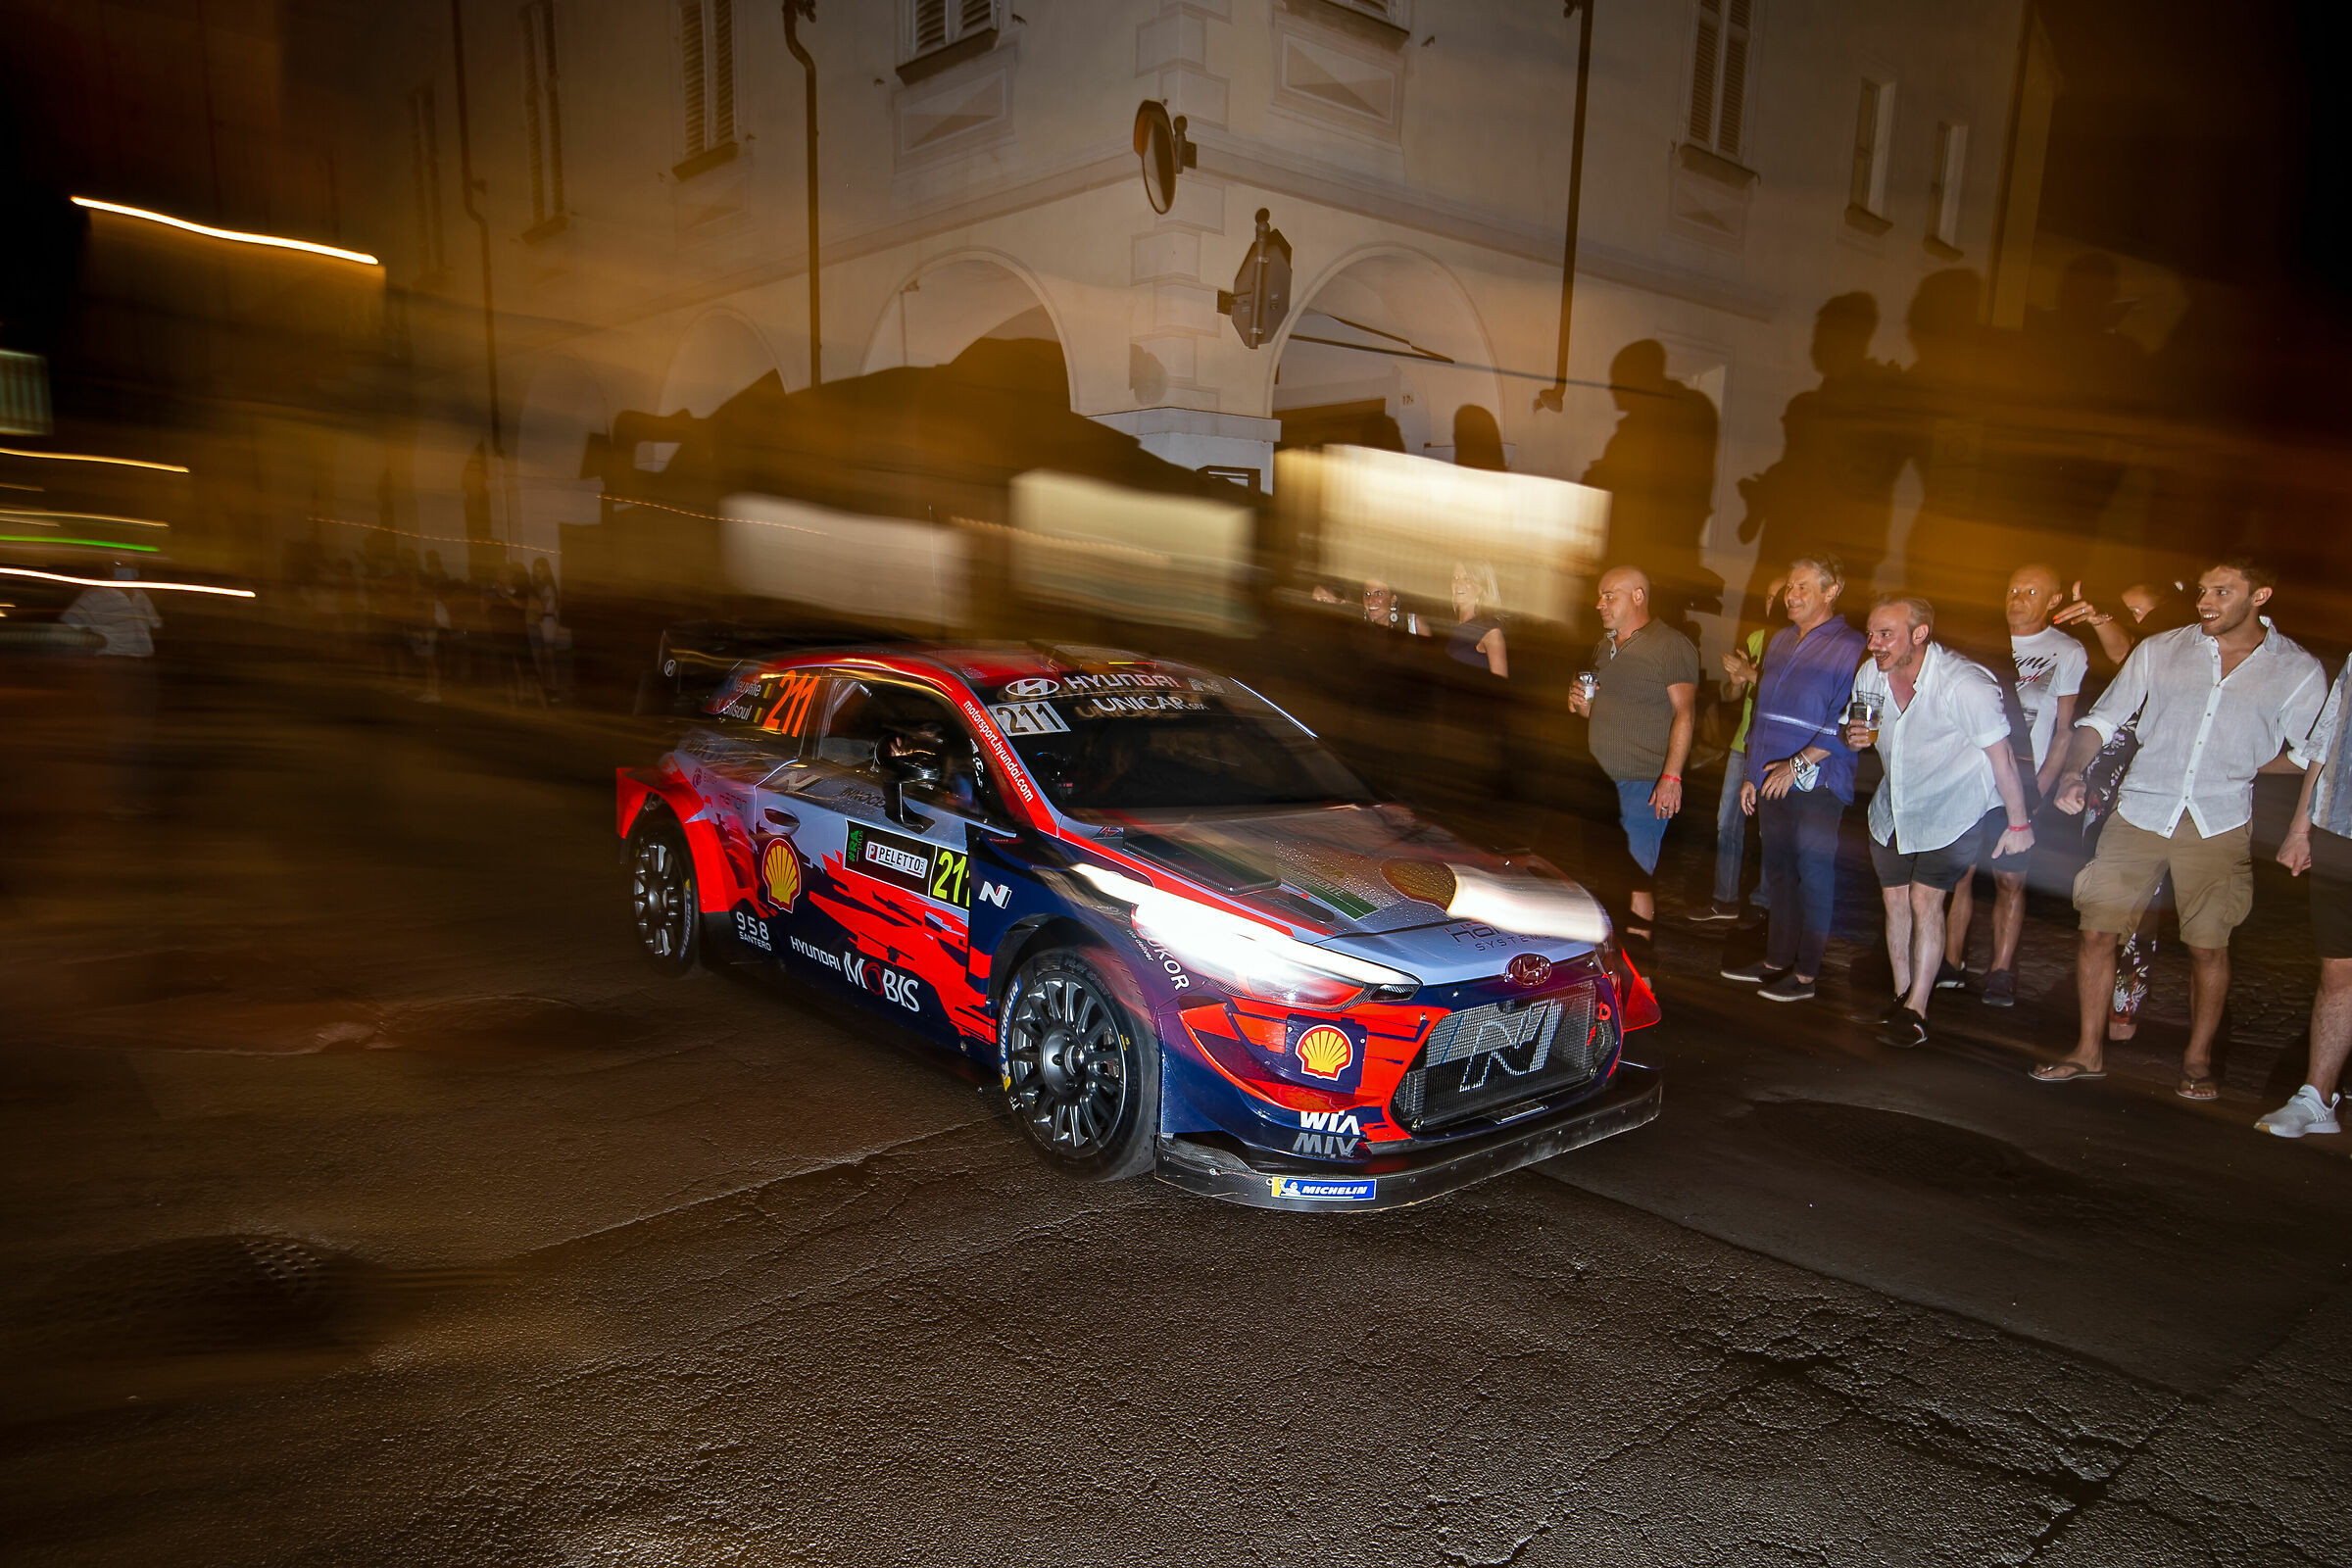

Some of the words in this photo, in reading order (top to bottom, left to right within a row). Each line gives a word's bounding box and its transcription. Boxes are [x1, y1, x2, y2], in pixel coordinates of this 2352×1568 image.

[1063, 673, 1182, 690] HYUNDAI
[761, 669, 820, 738] 211
[1091, 696, 1191, 711] UNICAR
[996, 703, 1063, 734] 211
[963, 700, 1034, 803] motorsport.hyundai.com
[878, 847, 921, 871] PELETTO
[736, 911, 769, 941] 958
[739, 931, 772, 952] SANTERO
[1135, 939, 1154, 961] deliver
[1475, 934, 1551, 952] SYSTEM
[790, 936, 842, 971] HYUNDAI
[843, 952, 920, 1012] MOBIS
[1001, 982, 1019, 1058] MICHELIN
[1301, 1185, 1368, 1195] MICHELIN
